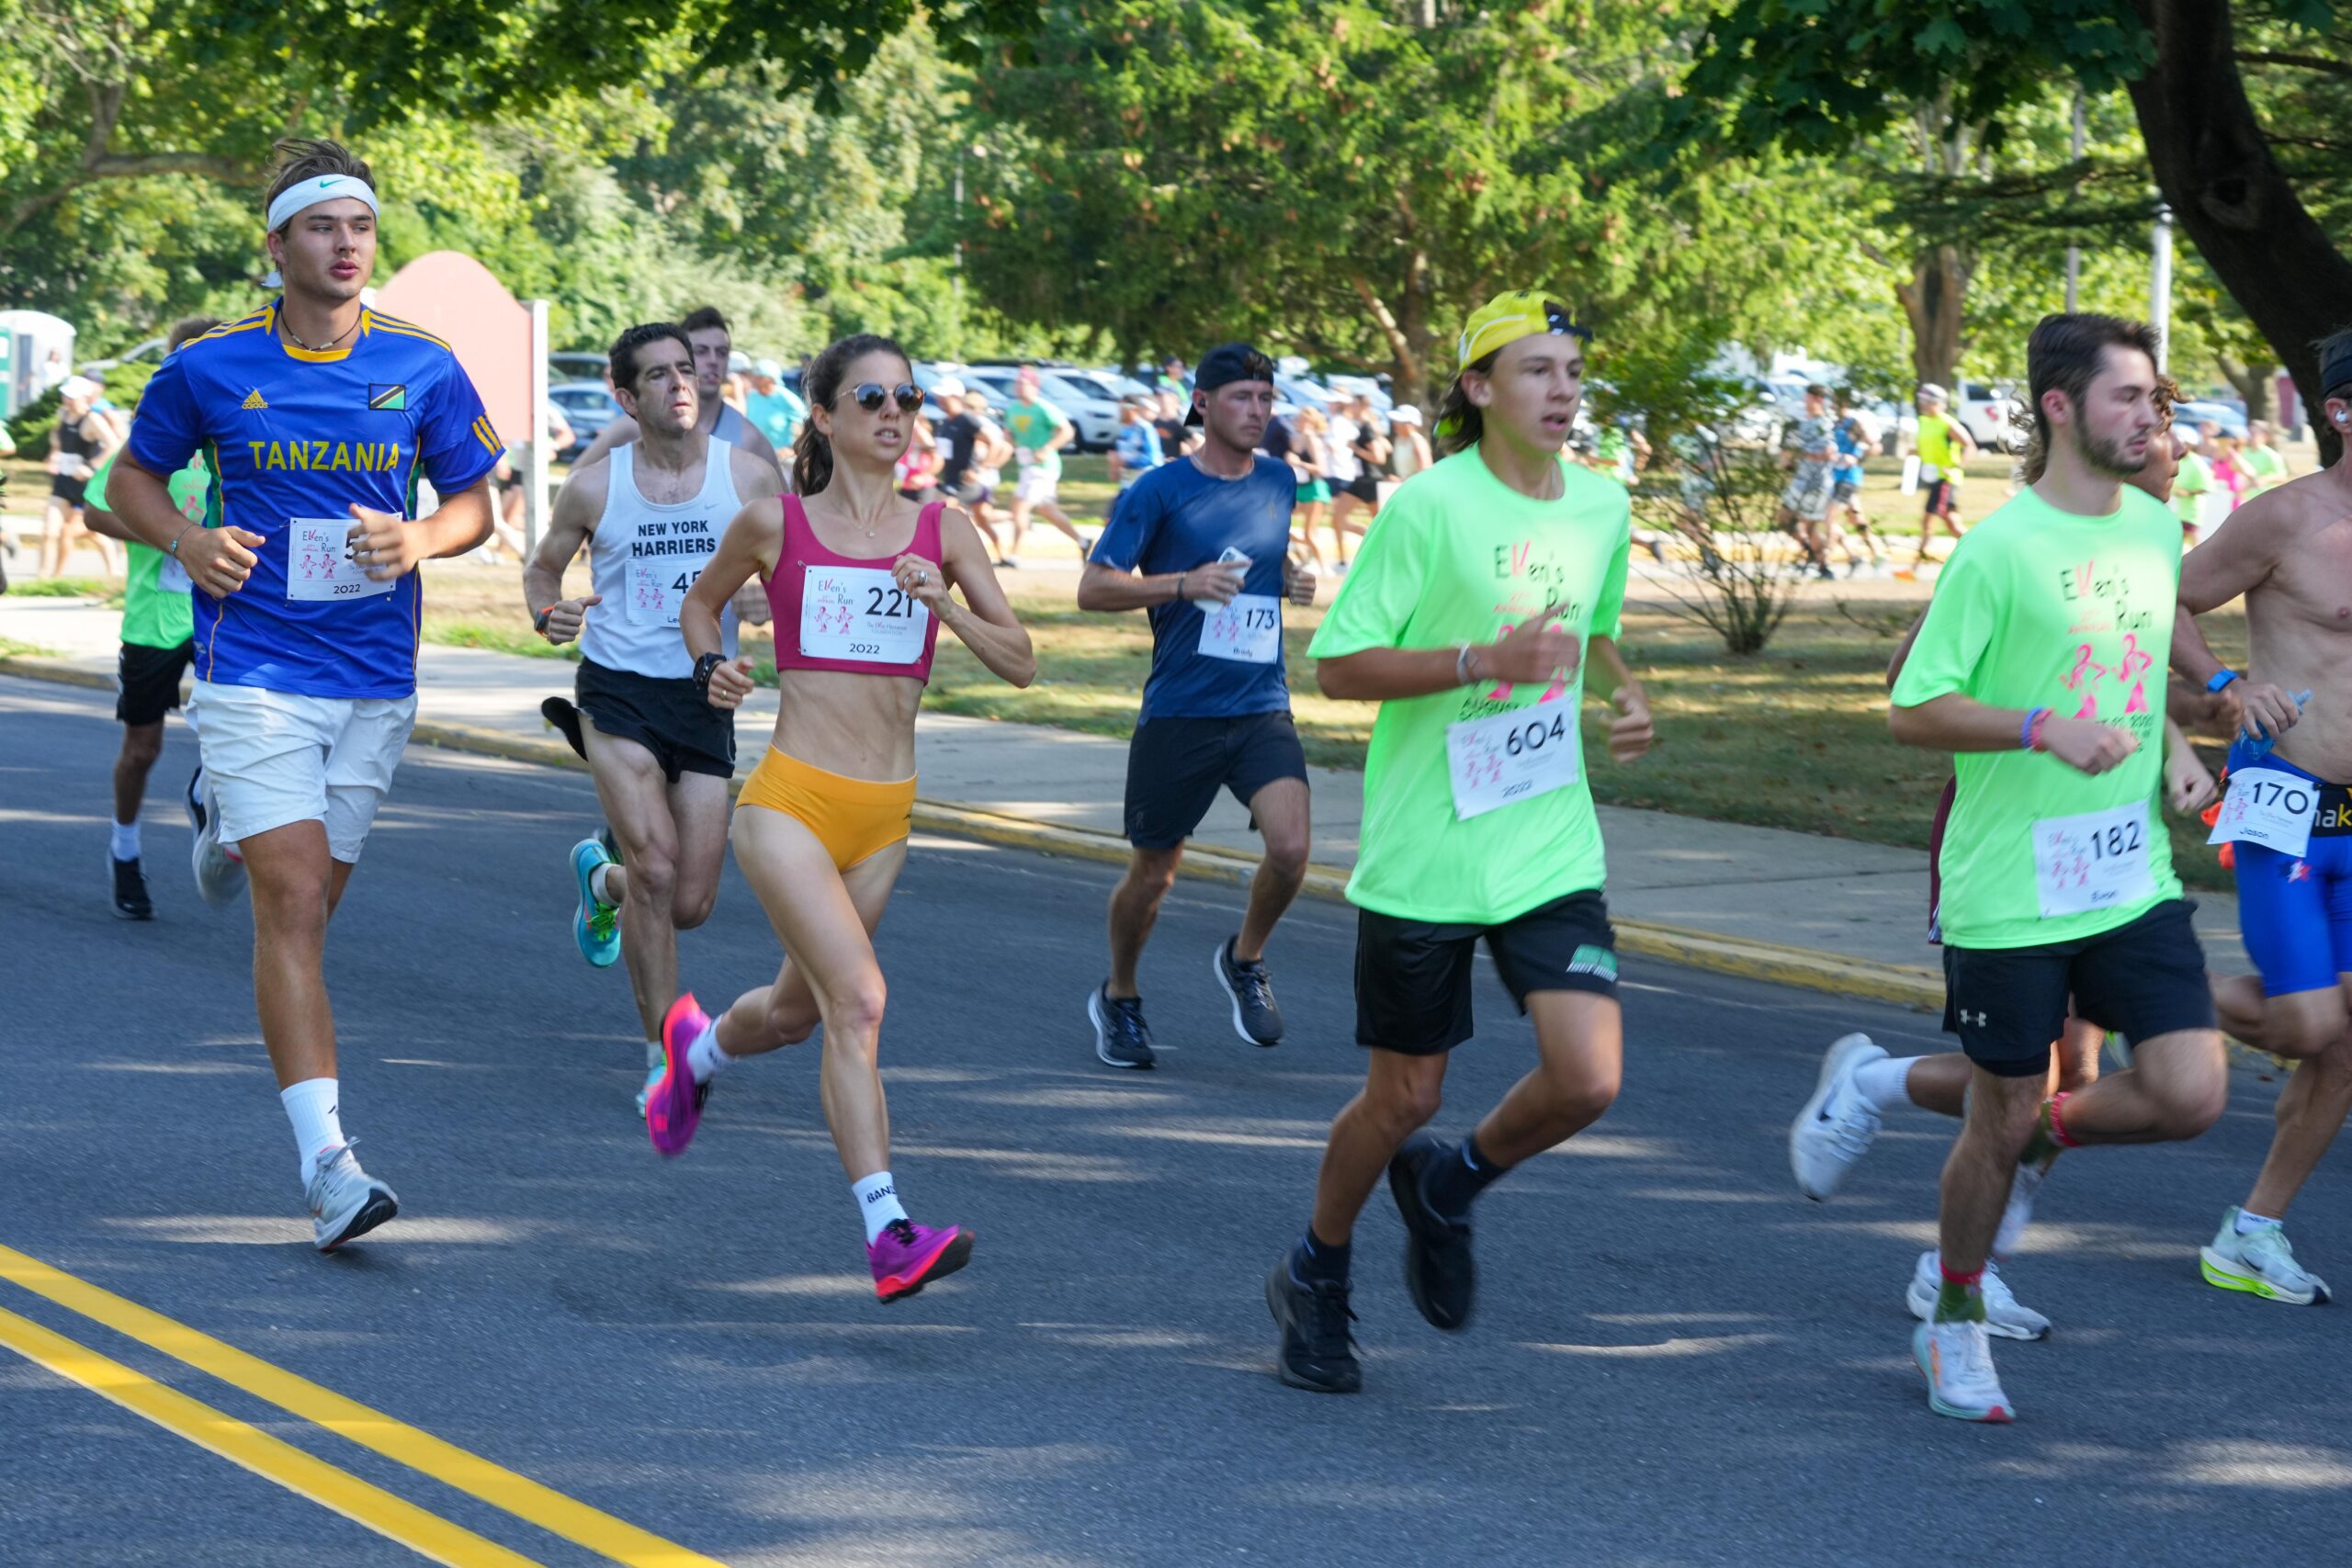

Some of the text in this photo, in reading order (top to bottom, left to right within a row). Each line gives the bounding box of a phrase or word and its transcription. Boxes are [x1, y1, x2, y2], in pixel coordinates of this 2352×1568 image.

[248, 441, 399, 471] TANZANIA
[639, 520, 708, 536] NEW YORK
[321, 543, 335, 552] Run
[632, 537, 716, 557] HARRIERS
[334, 584, 361, 594] 2022
[837, 593, 854, 605] Run
[865, 587, 913, 618] 221
[1247, 608, 1275, 630] 173
[849, 643, 880, 655] 2022
[1507, 712, 1566, 756] 604
[2253, 782, 2309, 815] 170
[2091, 819, 2143, 860] 182
